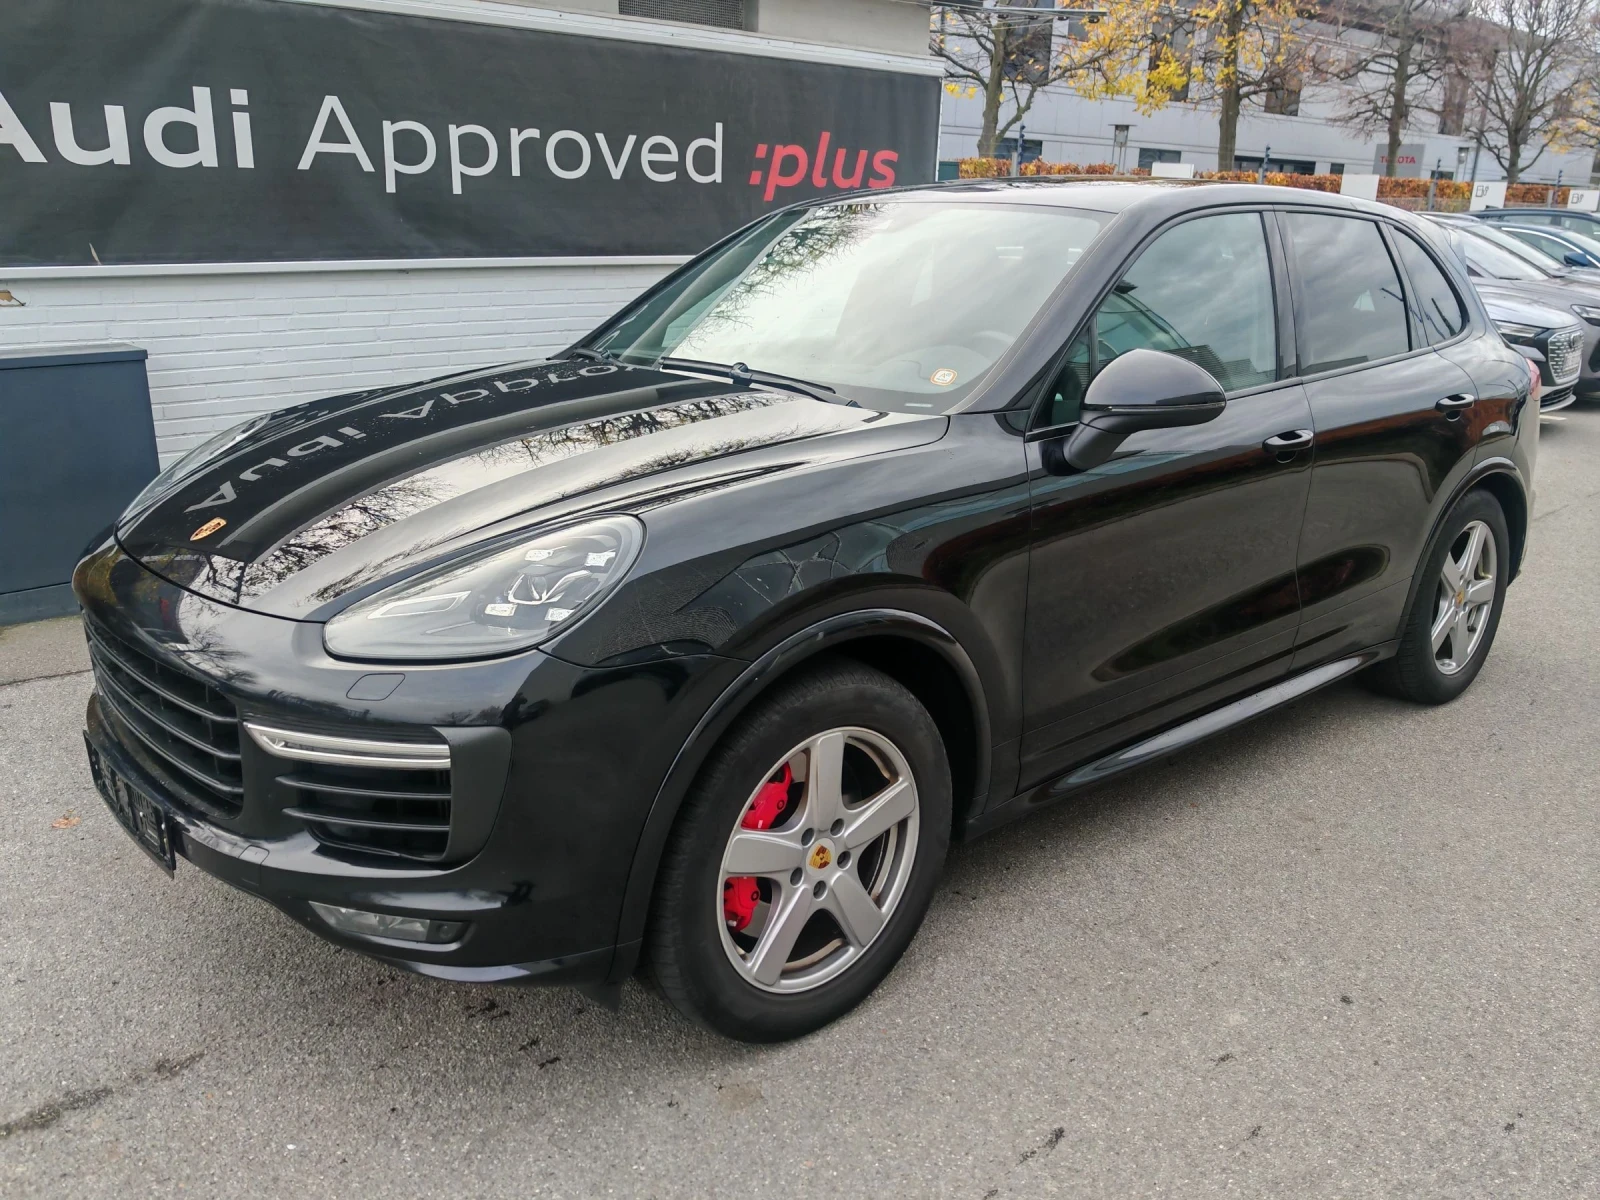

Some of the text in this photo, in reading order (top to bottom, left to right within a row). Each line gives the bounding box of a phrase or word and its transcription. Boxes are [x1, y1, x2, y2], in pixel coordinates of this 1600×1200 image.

[297, 94, 723, 195] Approved
[749, 131, 898, 202] :plus
[1380, 155, 1416, 164] TOTA
